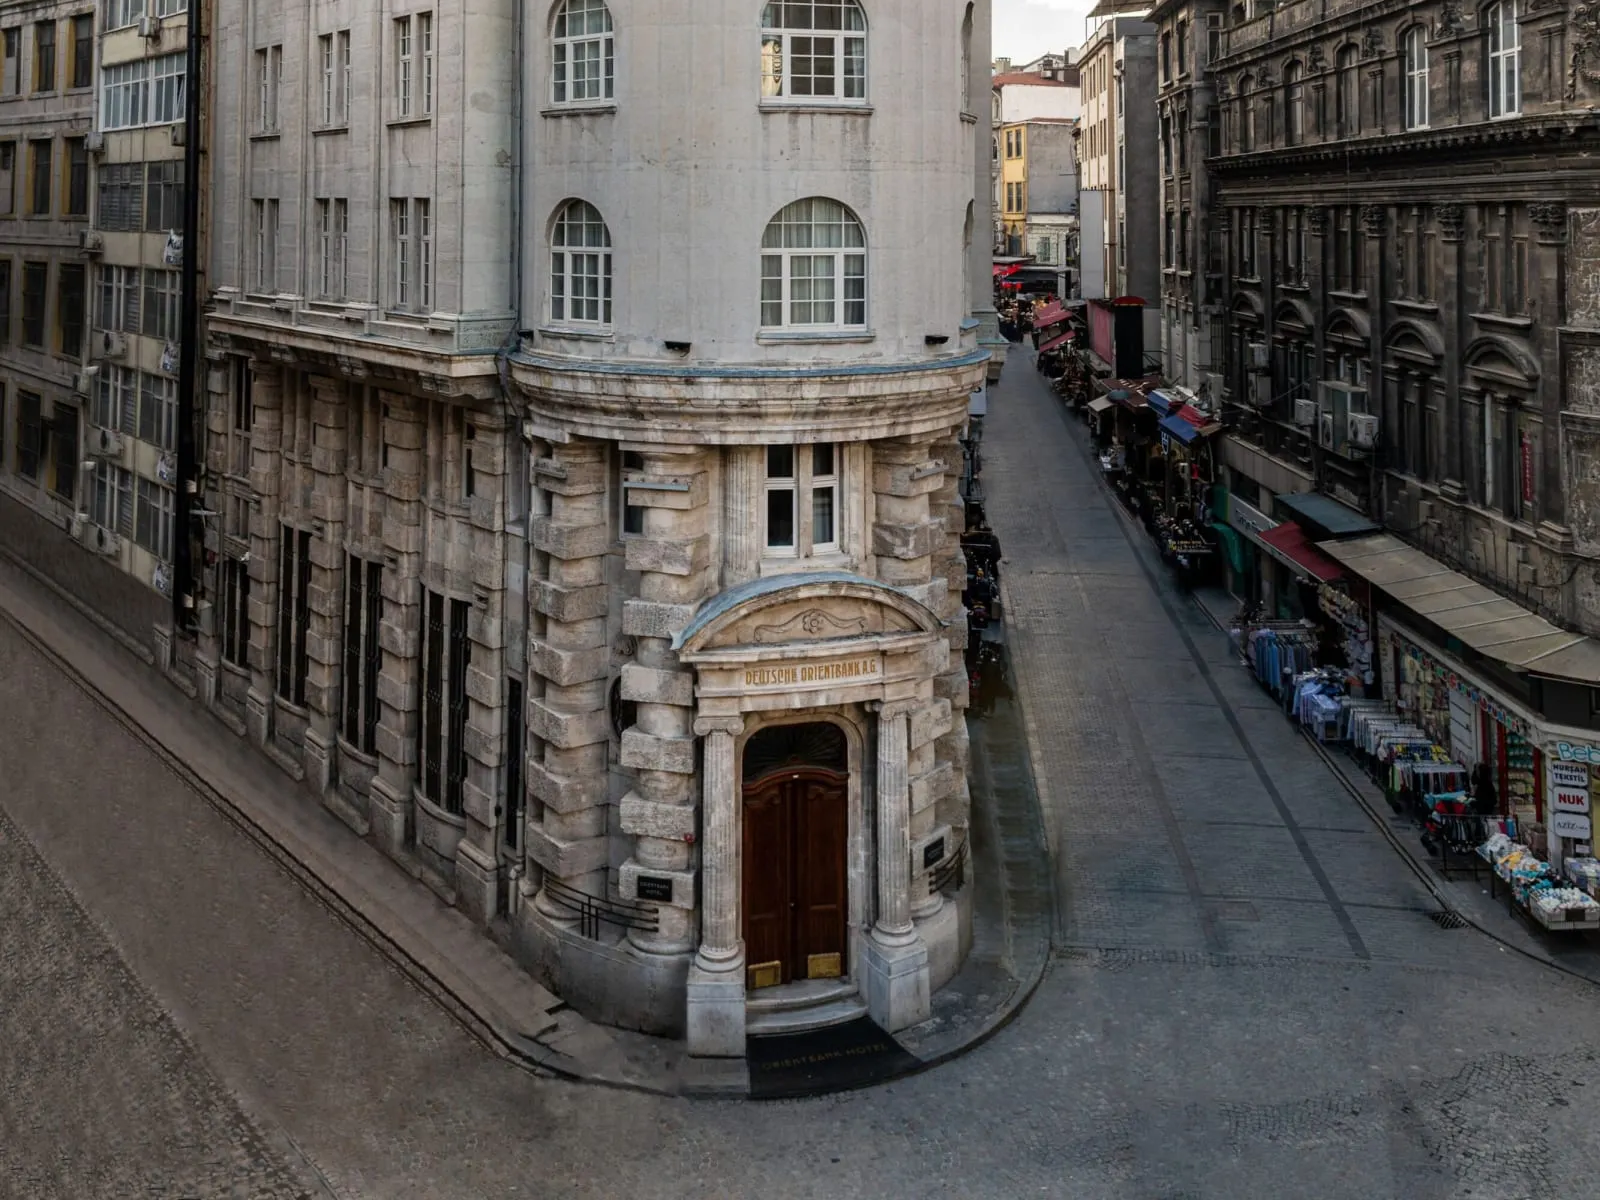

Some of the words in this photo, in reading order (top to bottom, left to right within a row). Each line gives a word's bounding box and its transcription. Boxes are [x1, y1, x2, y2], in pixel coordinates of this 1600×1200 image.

[801, 661, 860, 681] ORIENTBANK
[1558, 793, 1585, 806] NUK
[846, 1043, 888, 1056] HOTEL
